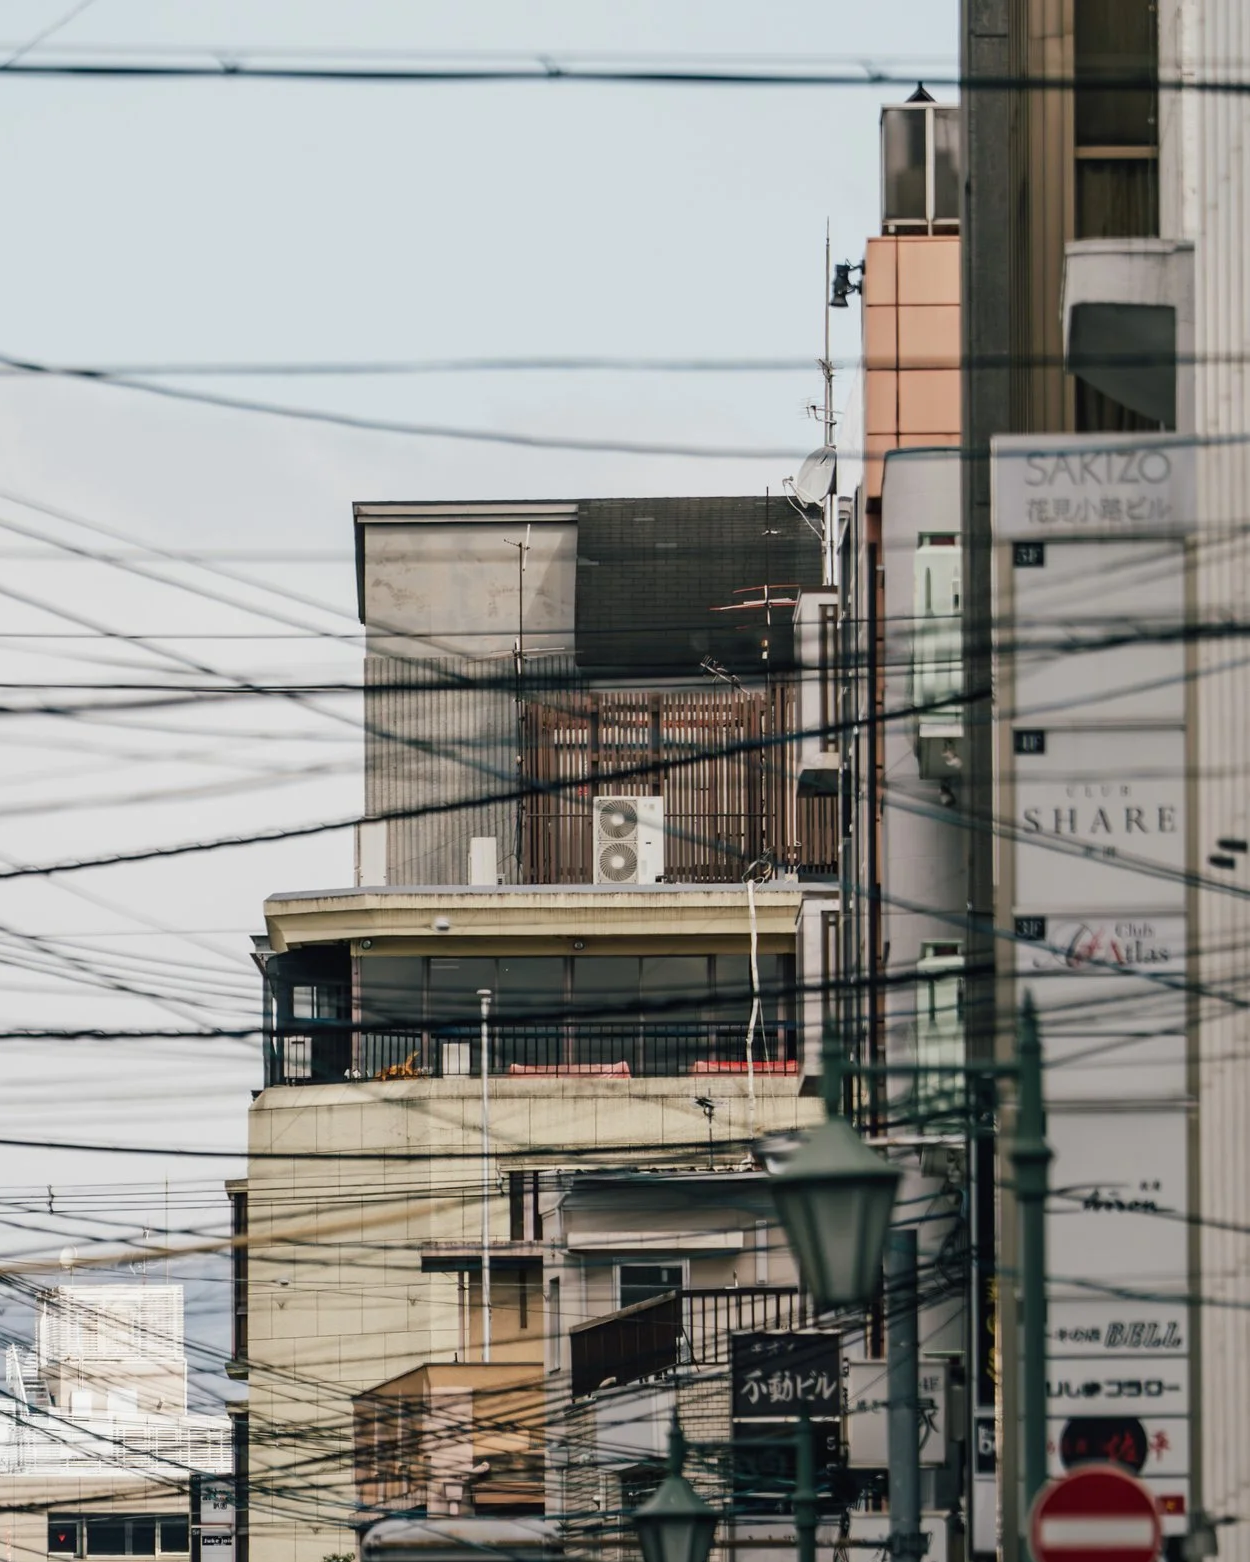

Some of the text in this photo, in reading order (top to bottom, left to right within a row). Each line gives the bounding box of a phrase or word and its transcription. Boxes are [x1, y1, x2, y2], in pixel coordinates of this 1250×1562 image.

[1025, 451, 1172, 487] SAKIZO
[1023, 807, 1177, 834] SHARE
[1109, 941, 1169, 965] Atlas
[1104, 1321, 1181, 1348] BELL
[740, 1369, 838, 1405] 不動ビル
